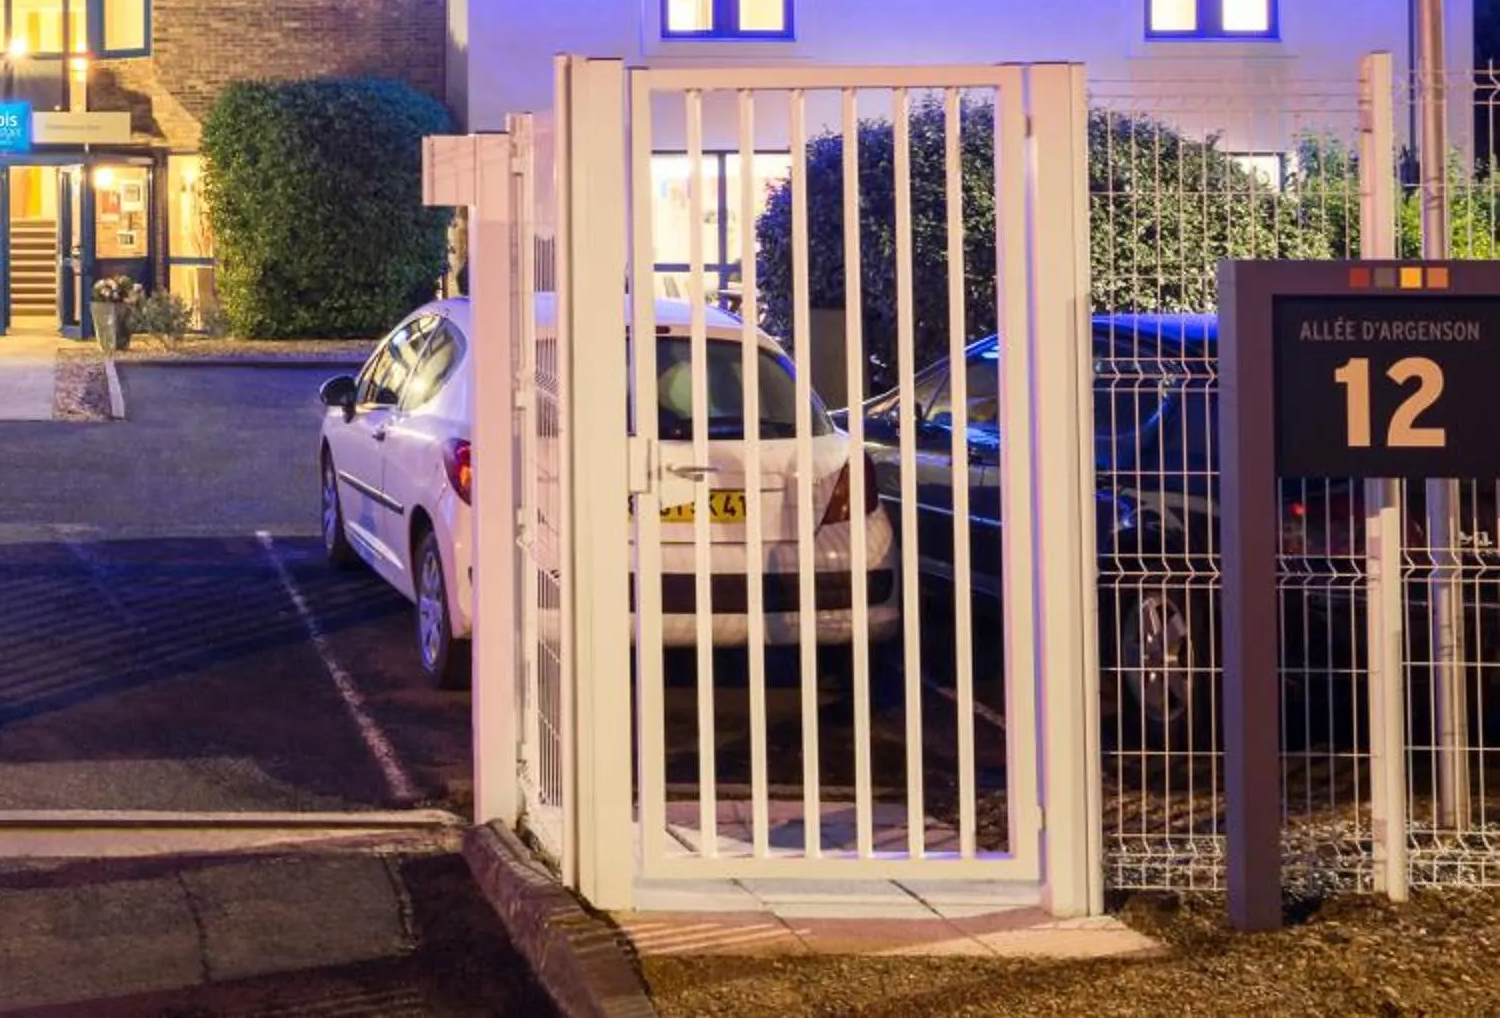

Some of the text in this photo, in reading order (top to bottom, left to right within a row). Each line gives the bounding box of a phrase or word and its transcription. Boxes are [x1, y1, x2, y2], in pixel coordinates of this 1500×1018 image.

[1300, 316, 1481, 341] ALLÉE D'ARGENSON
[1334, 356, 1446, 447] 12
